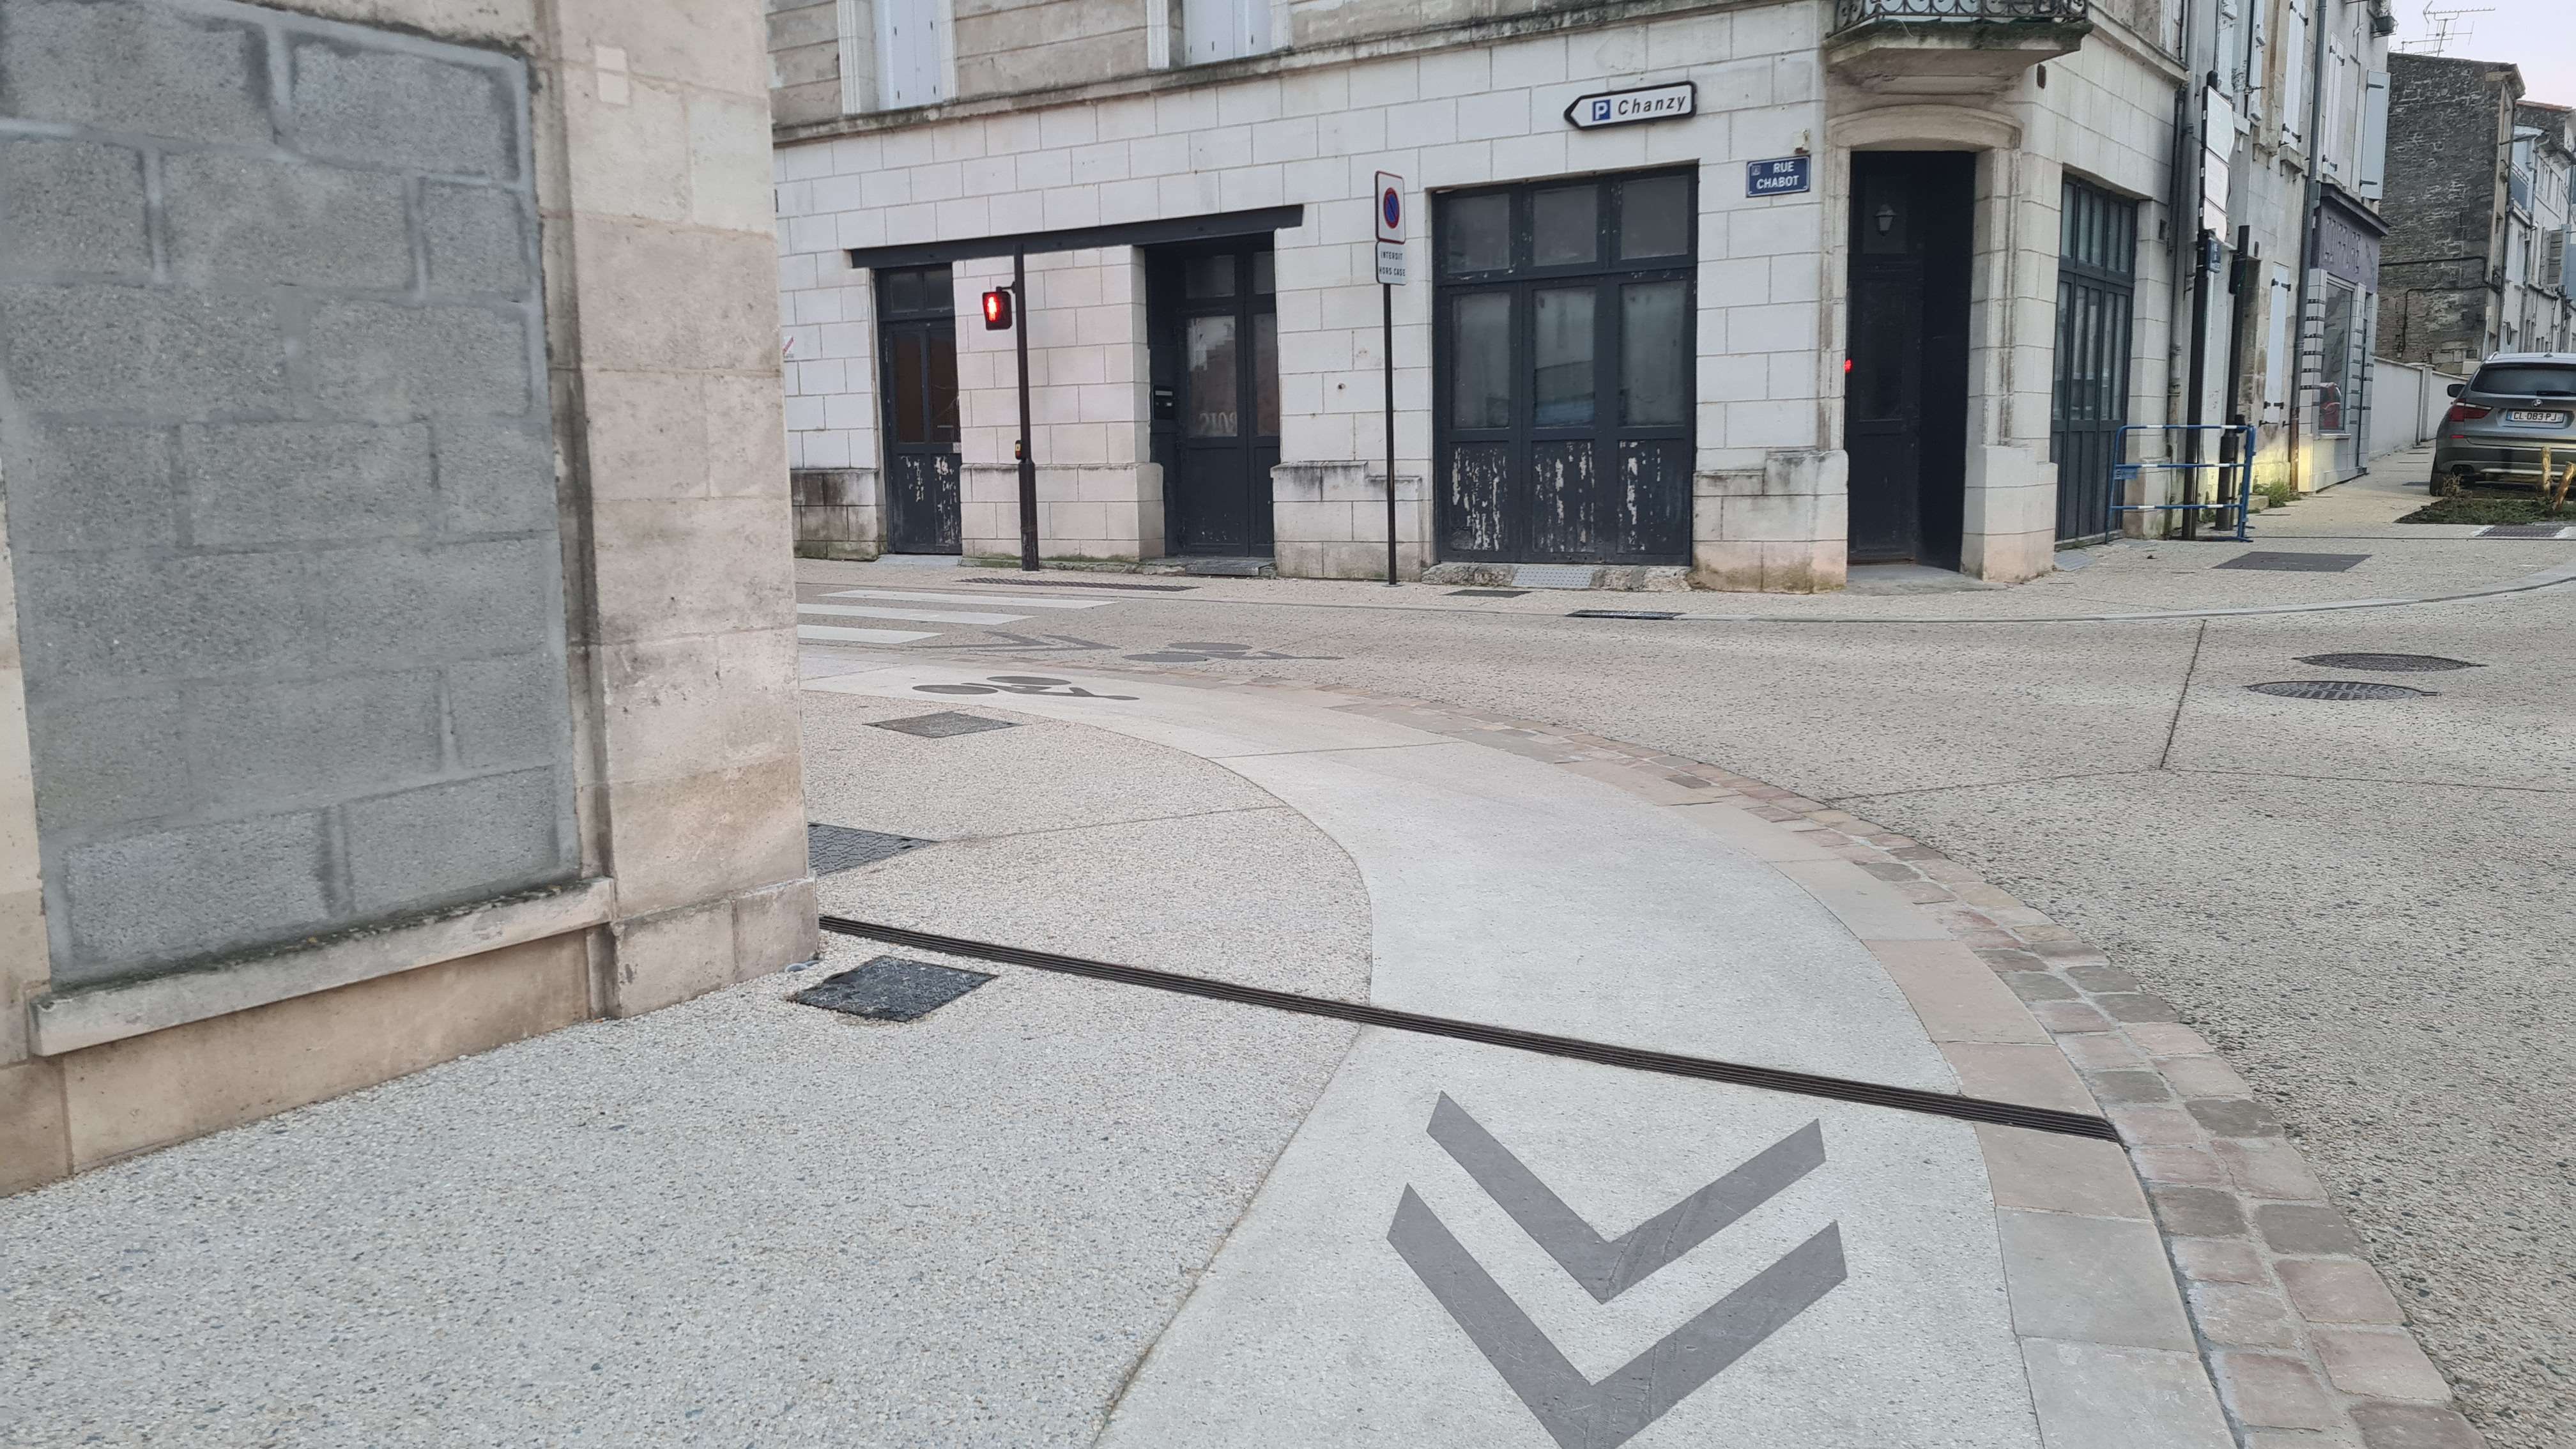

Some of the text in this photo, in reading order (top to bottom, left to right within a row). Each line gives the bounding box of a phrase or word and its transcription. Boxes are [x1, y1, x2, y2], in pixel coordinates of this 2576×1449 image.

[1618, 96, 1687, 116] Chanzy
[1773, 161, 1795, 174] RUE
[1756, 175, 1800, 190] CHABOT
[1393, 268, 1406, 277] CASE
